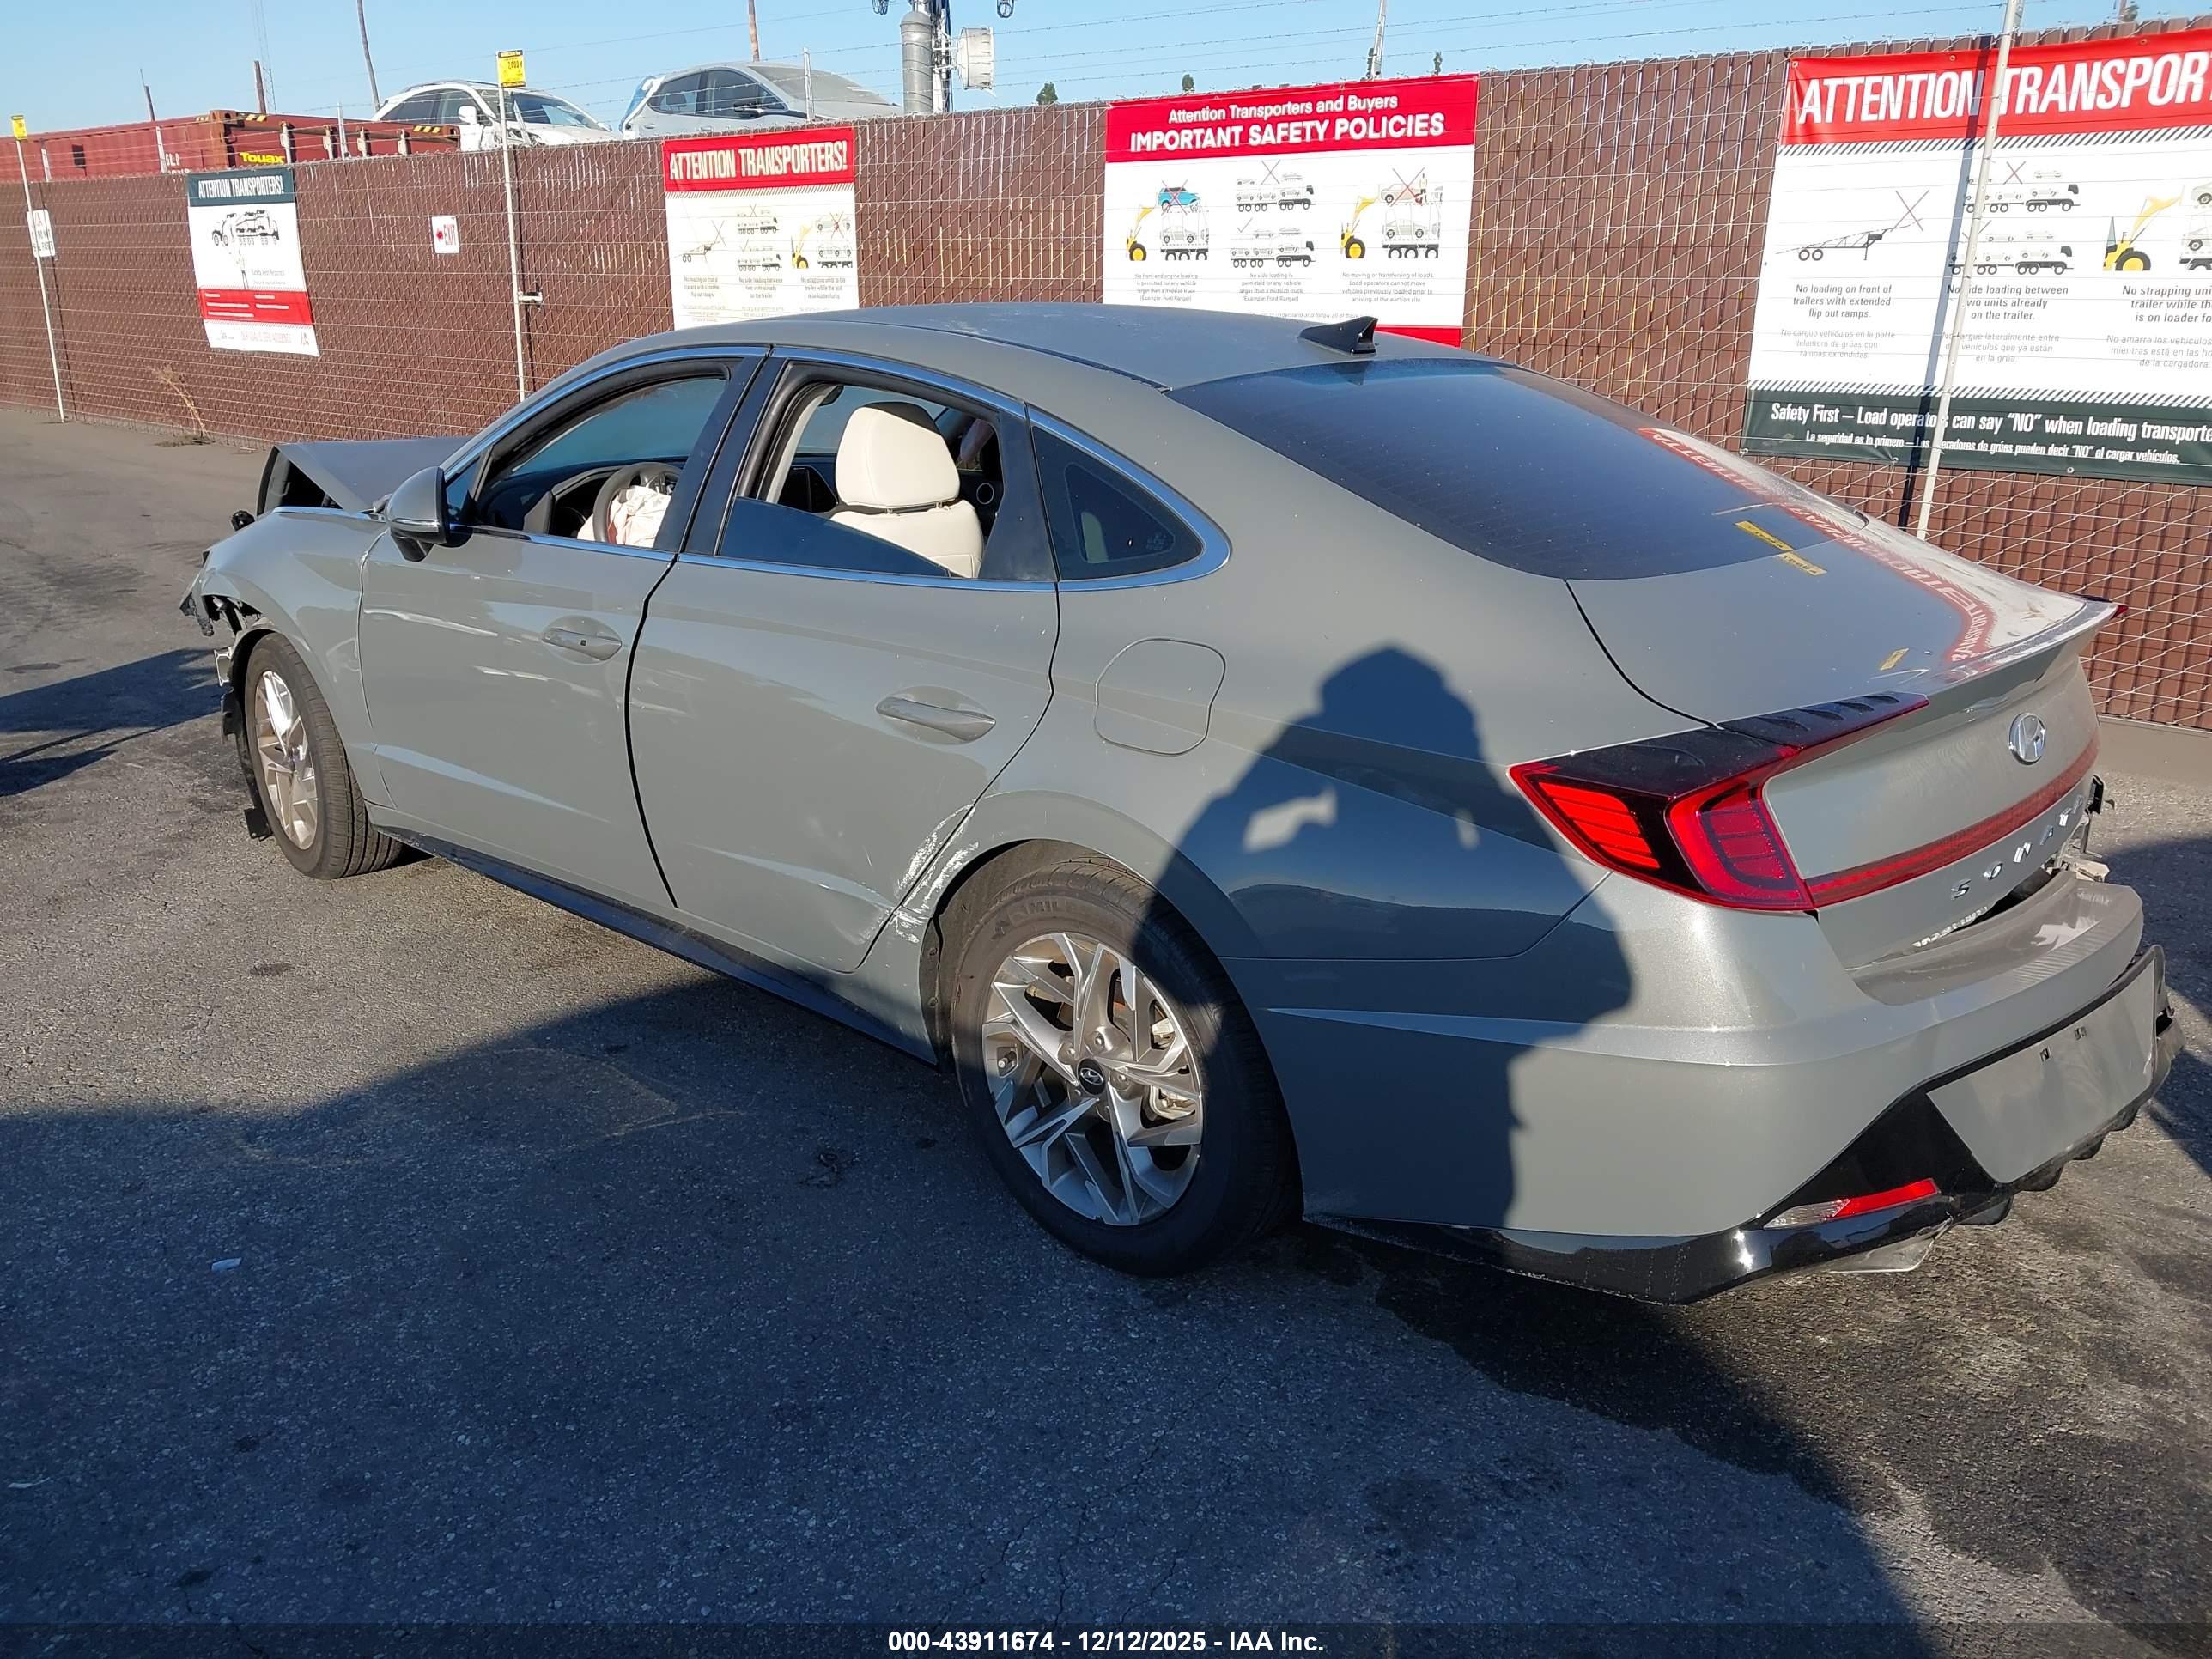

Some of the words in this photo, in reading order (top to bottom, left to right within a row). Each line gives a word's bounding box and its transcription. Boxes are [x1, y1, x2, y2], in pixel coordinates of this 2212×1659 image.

[1799, 70, 1984, 125] ATTENTION
[1998, 50, 2212, 116] TRANSPOR
[1168, 105, 1226, 125] Attention
[1230, 100, 1313, 122] Transporters
[1316, 96, 1344, 112] and
[1347, 94, 1398, 113] Buyers
[1130, 125, 1244, 152] IMPORTANT
[1248, 119, 1330, 146] SAFETY
[1334, 112, 1445, 141] POLICIES
[240, 152, 285, 164] Touax
[670, 149, 736, 180] ATTENTION
[738, 140, 848, 177] TRANSPORTERS!
[198, 177, 229, 198] ATTENTION
[230, 175, 284, 197] TRANSPORTERS!
[1796, 284, 1808, 294] No
[1810, 284, 1844, 295] loading
[1845, 285, 1856, 294] on
[1858, 284, 1881, 294] front
[1882, 284, 1893, 294] of
[1947, 284, 1961, 294] No
[1967, 284, 1984, 294] ide
[1985, 284, 2021, 295] loading
[2025, 284, 2069, 295] between
[2122, 285, 2137, 295] No
[2140, 285, 2191, 298] strapping
[1793, 296, 1824, 306] trailers
[1826, 296, 1847, 306] with
[1849, 296, 1892, 307] extended
[1984, 299, 2008, 307] units
[2011, 298, 2048, 309] already
[2130, 299, 2164, 309] trailer
[2166, 299, 2197, 309] while
[2200, 299, 2212, 309] th
[1808, 307, 1822, 319] flip
[1825, 309, 1839, 318] out
[1841, 310, 1872, 320] ramps.
[1985, 311, 2001, 319] the
[2003, 311, 2035, 320] trailer.
[2135, 312, 2144, 322] is
[2164, 313, 2198, 323] loader
[1960, 333, 1984, 342] argue
[2038, 333, 2060, 342] entre
[2106, 334, 2119, 343] No
[2154, 336, 2167, 344] los
[2017, 344, 2027, 353] ya
[2111, 347, 2148, 356] mientras
[2186, 348, 2199, 356] las
[1771, 403, 1810, 425] Safety
[1813, 404, 1840, 423] First
[1856, 406, 1887, 425] Load
[1890, 410, 1949, 430] operatos
[1952, 414, 1975, 429] can
[1978, 416, 2003, 434] say
[2045, 415, 2083, 434] when
[2087, 416, 2138, 442] loading
[2141, 421, 2212, 445] transporte
[1806, 430, 1815, 442] La
[1817, 432, 1853, 446] seguridad
[1855, 434, 1864, 444] es
[1875, 434, 1905, 451] primero
[1942, 437, 1976, 451] eradores
[1977, 440, 1989, 452] de
[2014, 442, 2045, 456] pueden
[2047, 443, 2069, 456] decir
[2094, 446, 2105, 459] al
[2106, 448, 2134, 463] cargar
